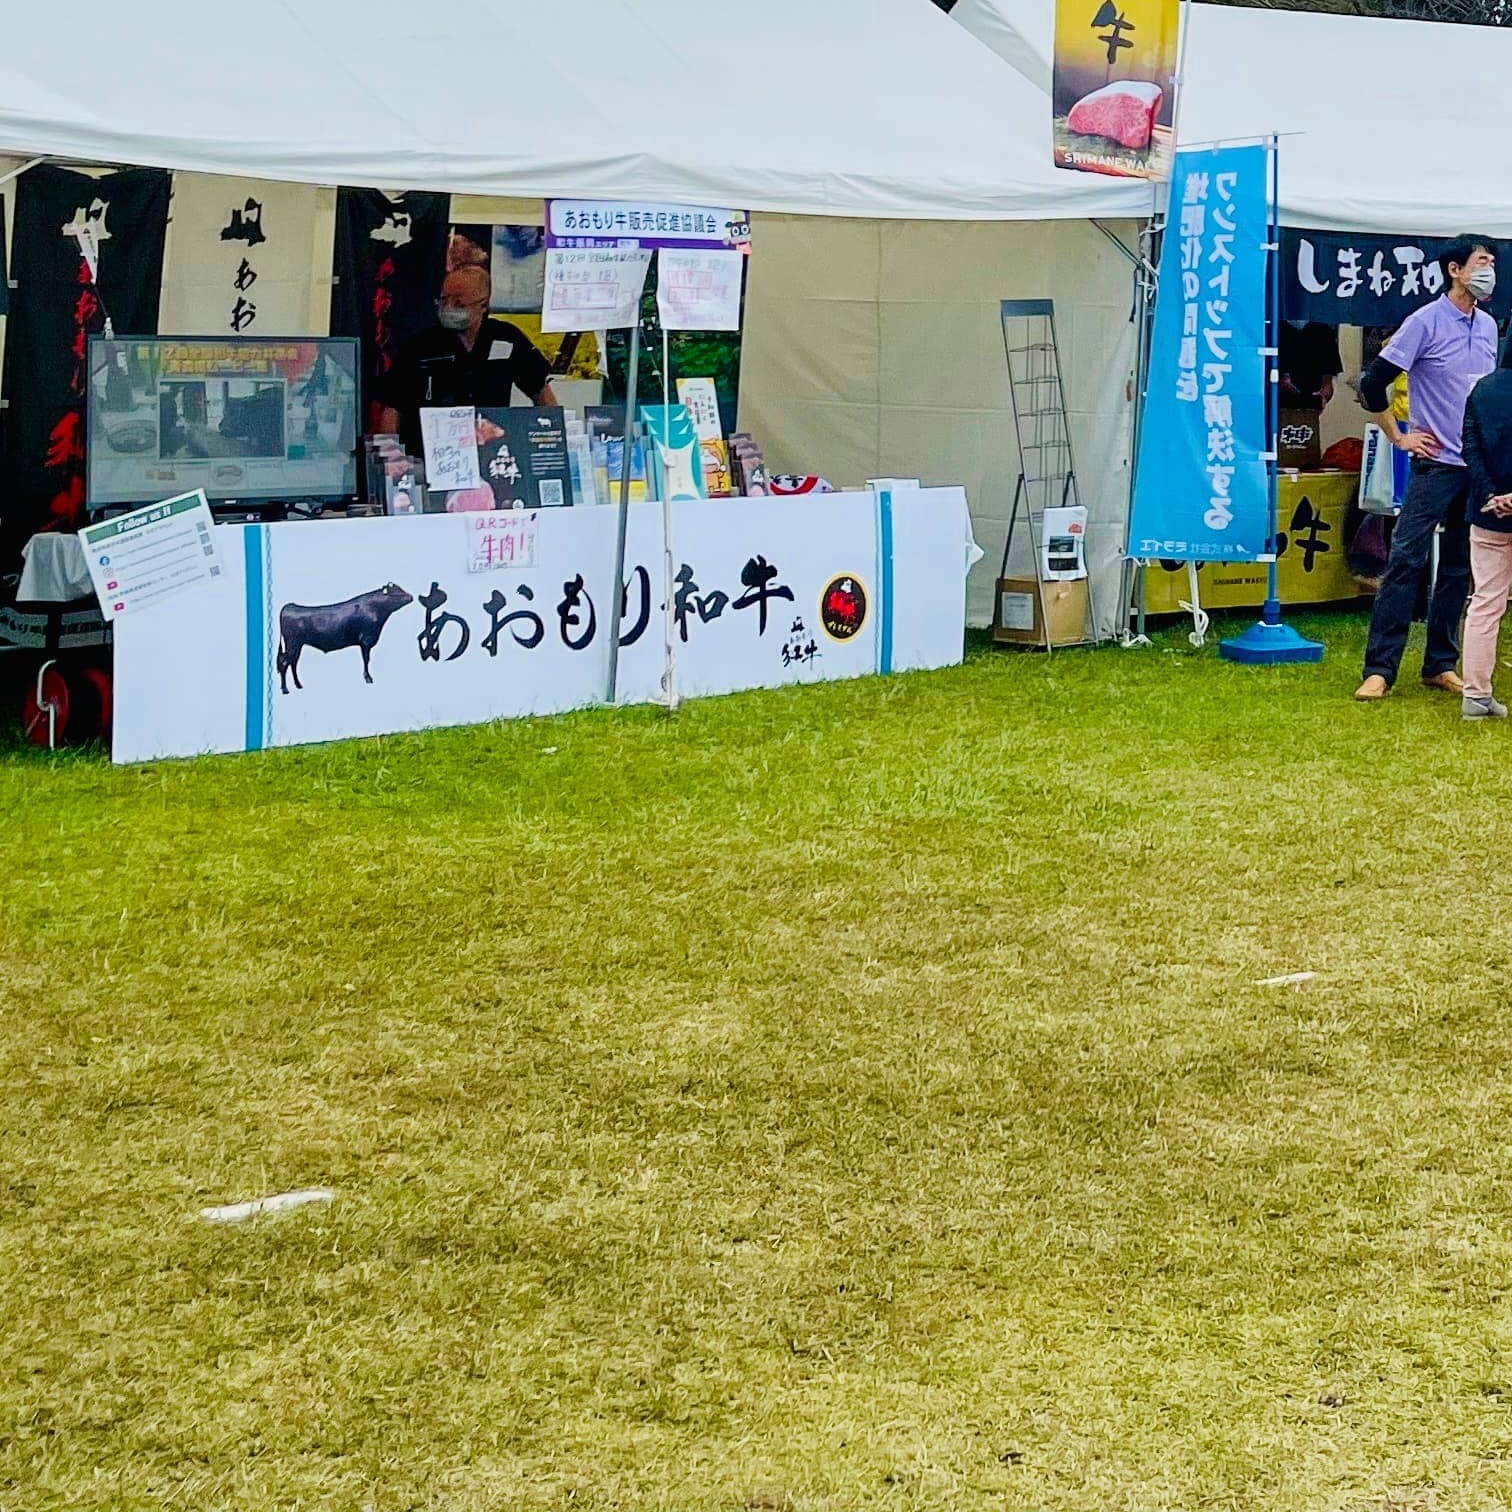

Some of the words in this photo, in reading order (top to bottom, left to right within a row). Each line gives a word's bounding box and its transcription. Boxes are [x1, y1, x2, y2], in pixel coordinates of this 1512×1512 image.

[1064, 151, 1124, 167] SHIMANE
[564, 209, 717, 233] あおもり牛販売促進協議会
[1298, 239, 1444, 297] しまね和
[117, 514, 148, 533] Follow
[417, 554, 795, 663] あおもり和牛
